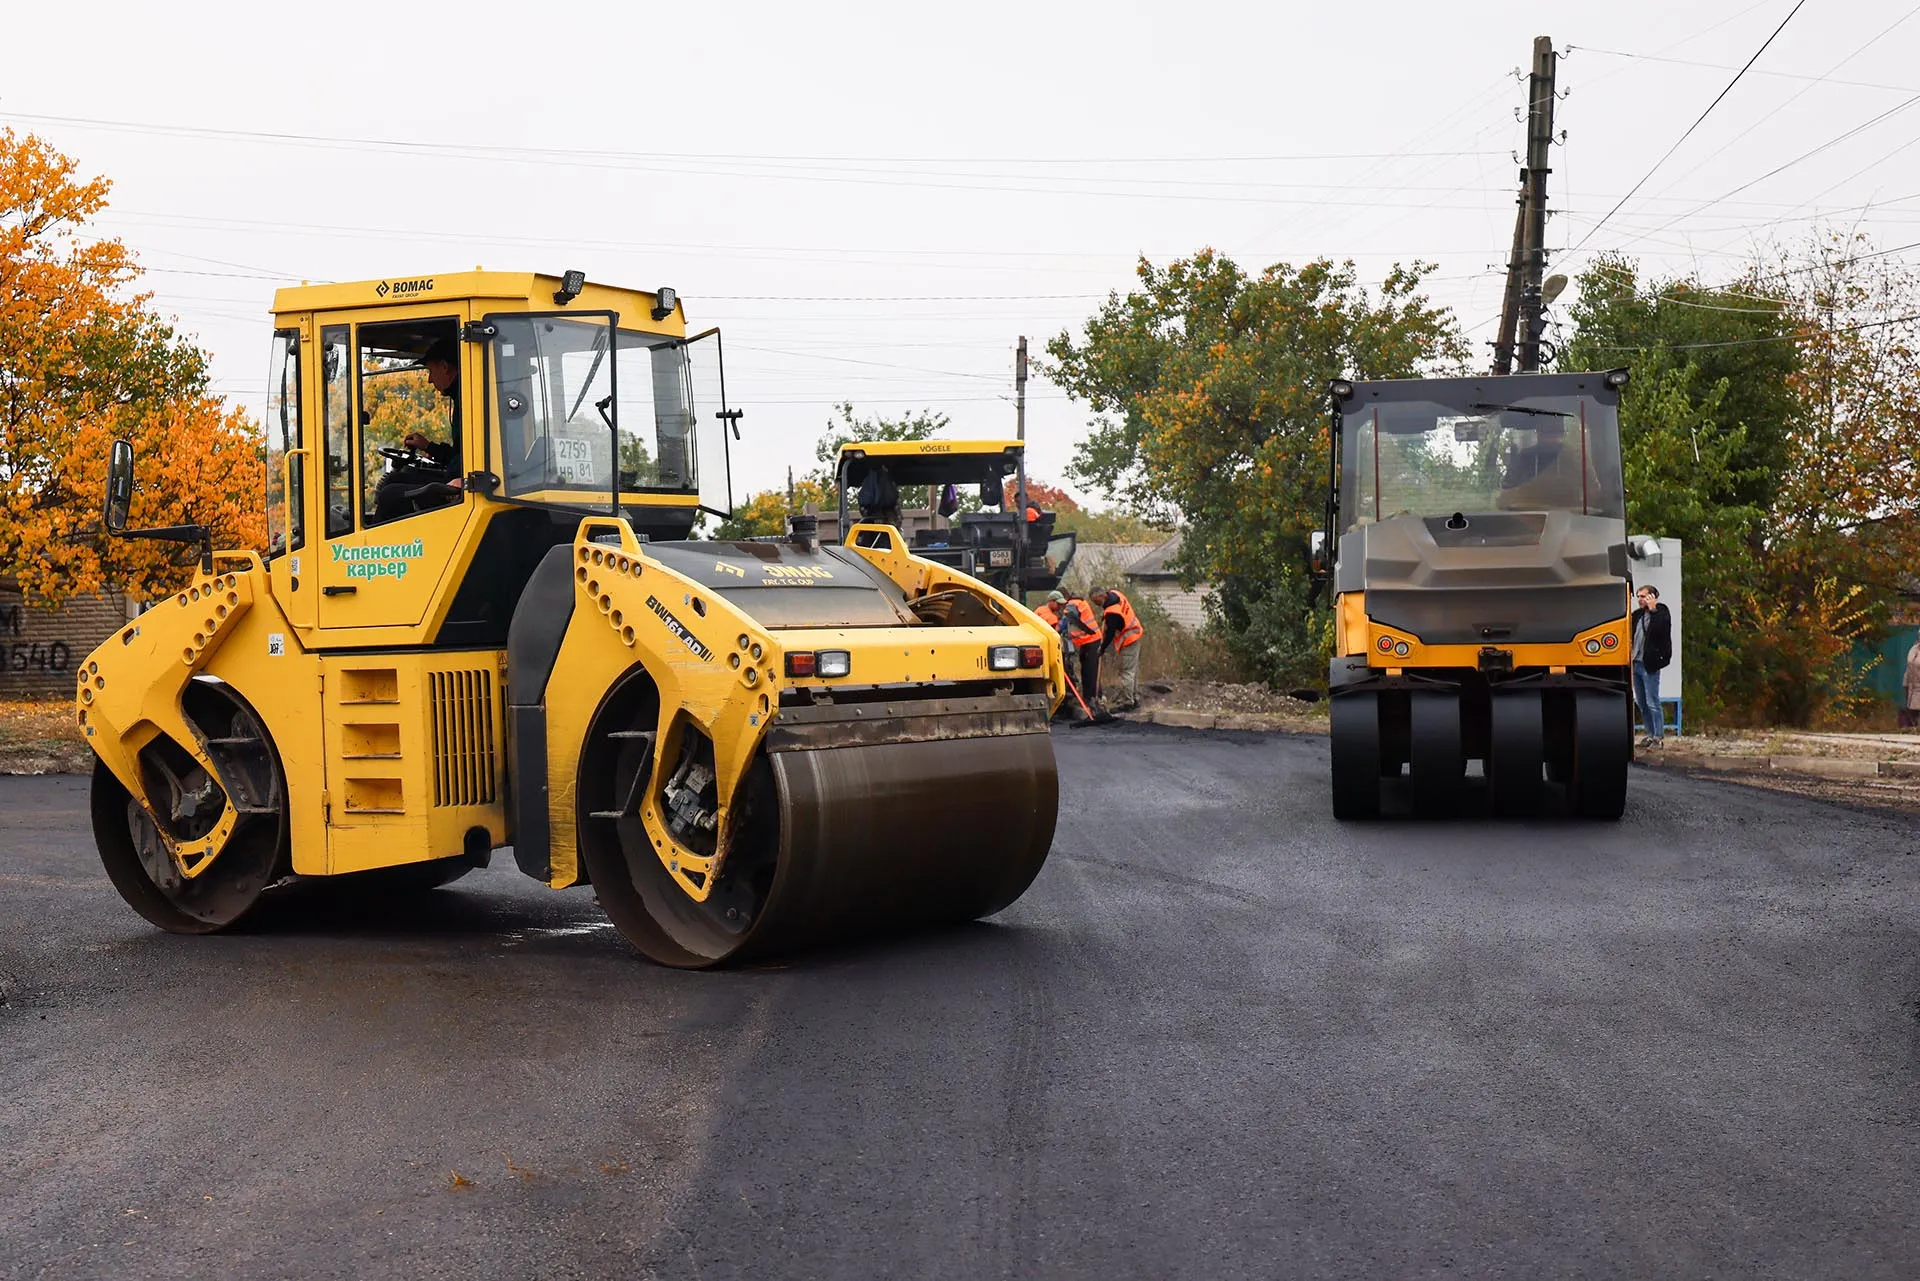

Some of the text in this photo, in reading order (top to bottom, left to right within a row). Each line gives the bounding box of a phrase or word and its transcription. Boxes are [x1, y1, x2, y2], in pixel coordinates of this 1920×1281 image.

[393, 279, 434, 293] BOMAG
[559, 440, 587, 459] 2759
[920, 444, 951, 452] VÖGELE
[579, 463, 591, 477] 81
[331, 538, 423, 562] Успенский
[346, 561, 408, 581] карьер
[762, 565, 834, 578] OMAG
[682, 635, 702, 656] AD
